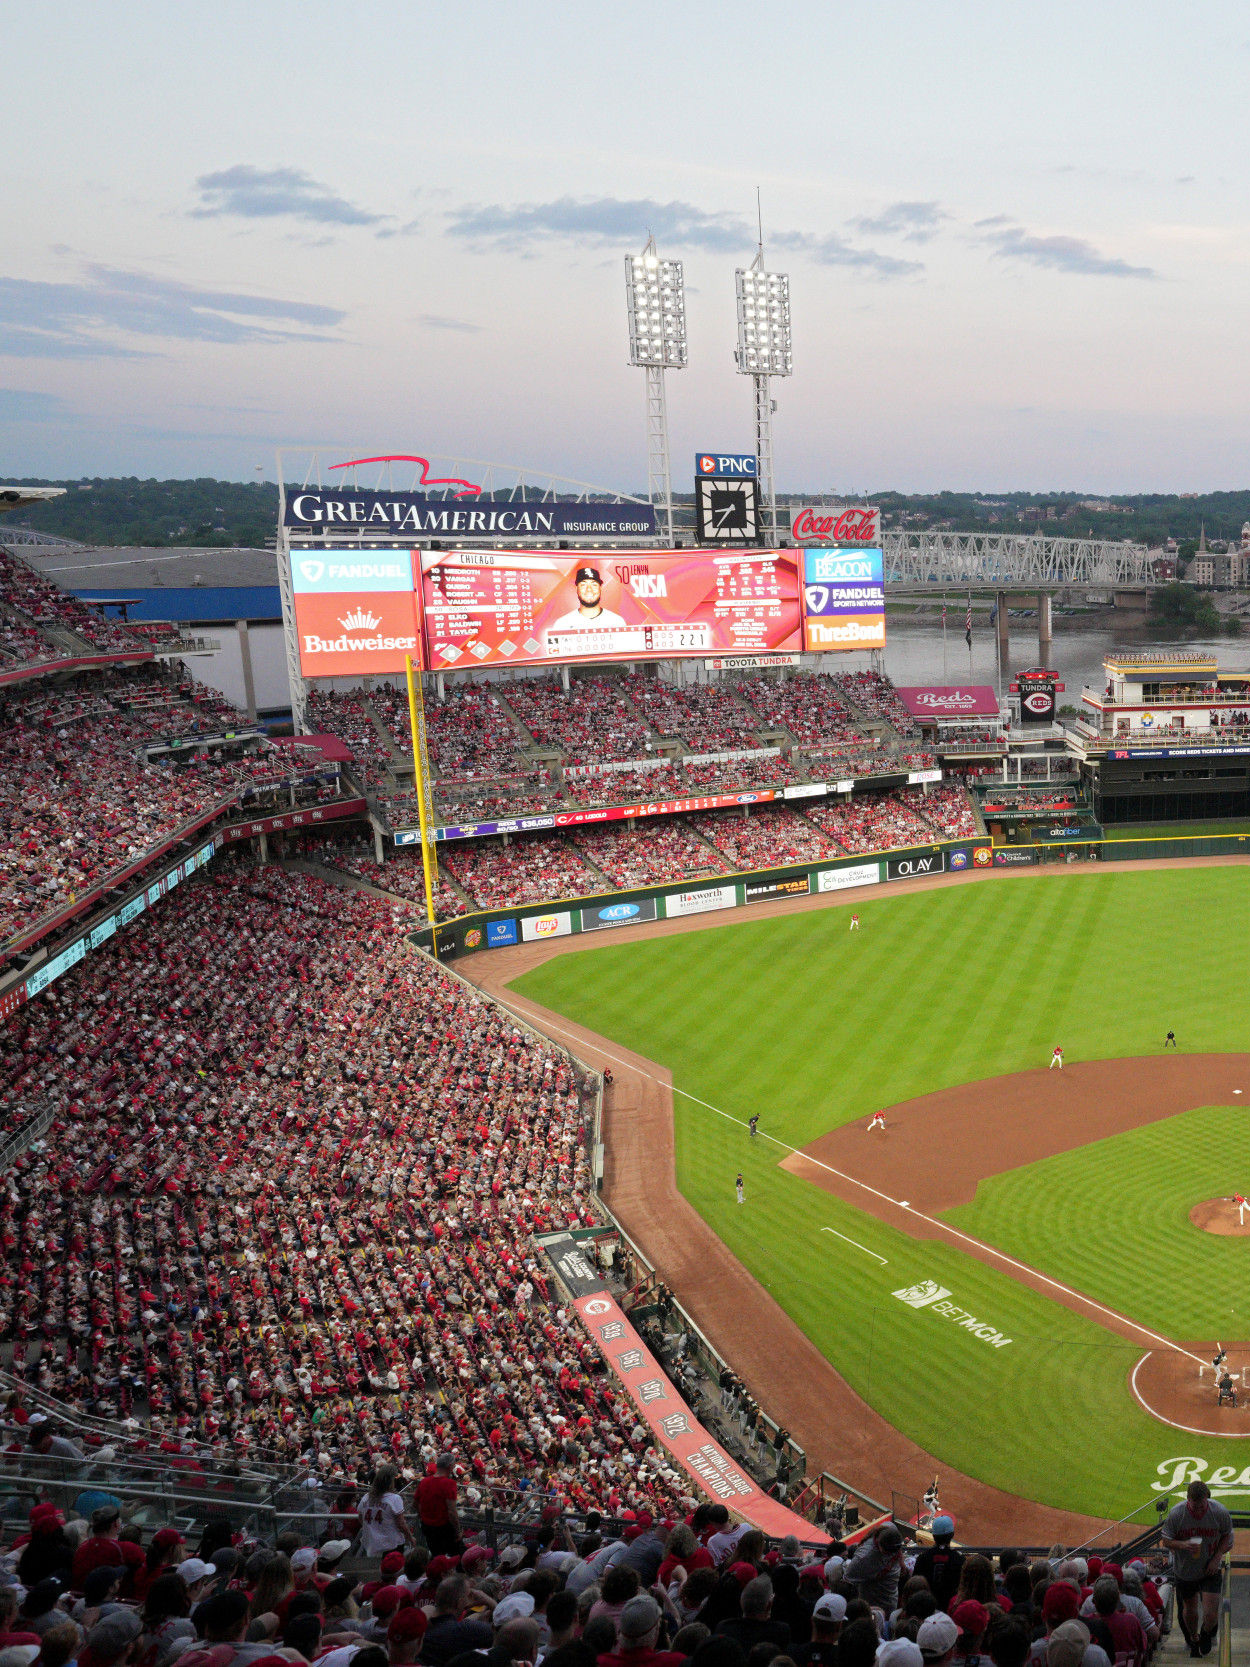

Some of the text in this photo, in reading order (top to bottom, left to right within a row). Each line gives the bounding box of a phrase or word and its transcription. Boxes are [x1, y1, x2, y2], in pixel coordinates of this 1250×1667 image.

[719, 458, 754, 473] PNC
[400, 507, 553, 531] AMERICAN
[563, 522, 616, 532] INSURANCE
[619, 522, 650, 532] GROUP
[792, 508, 879, 541] Coca-Cola
[460, 555, 495, 565] CHICAGO
[815, 558, 872, 577] BEACON
[329, 564, 406, 579] FANDUEL
[615, 564, 649, 584] 50 LENYN
[629, 574, 668, 598] SOSA
[833, 588, 884, 600] FANDUEL
[808, 623, 883, 642] ThreeBond
[304, 635, 416, 653] Budweiser
[724, 657, 793, 667] TOYOTA TUNDRA
[1021, 684, 1052, 692] TUNDRA
[916, 691, 977, 707] Reds
[1050, 828, 1080, 836] altafiber
[898, 858, 933, 876] OLAY
[838, 873, 877, 884] DEVELOPMENT
[680, 889, 722, 902] Hoxworth
[606, 906, 631, 918] ACR
[536, 918, 558, 931] Lay's
[931, 1301, 1013, 1348] BETMGM
[643, 1379, 663, 1402] 1970
[665, 1414, 687, 1437] 1972
[686, 1453, 736, 1499] CHAMPIONS
[700, 1444, 753, 1496] NATIONAL LEAGUE
[364, 1510, 383, 1525] 44
